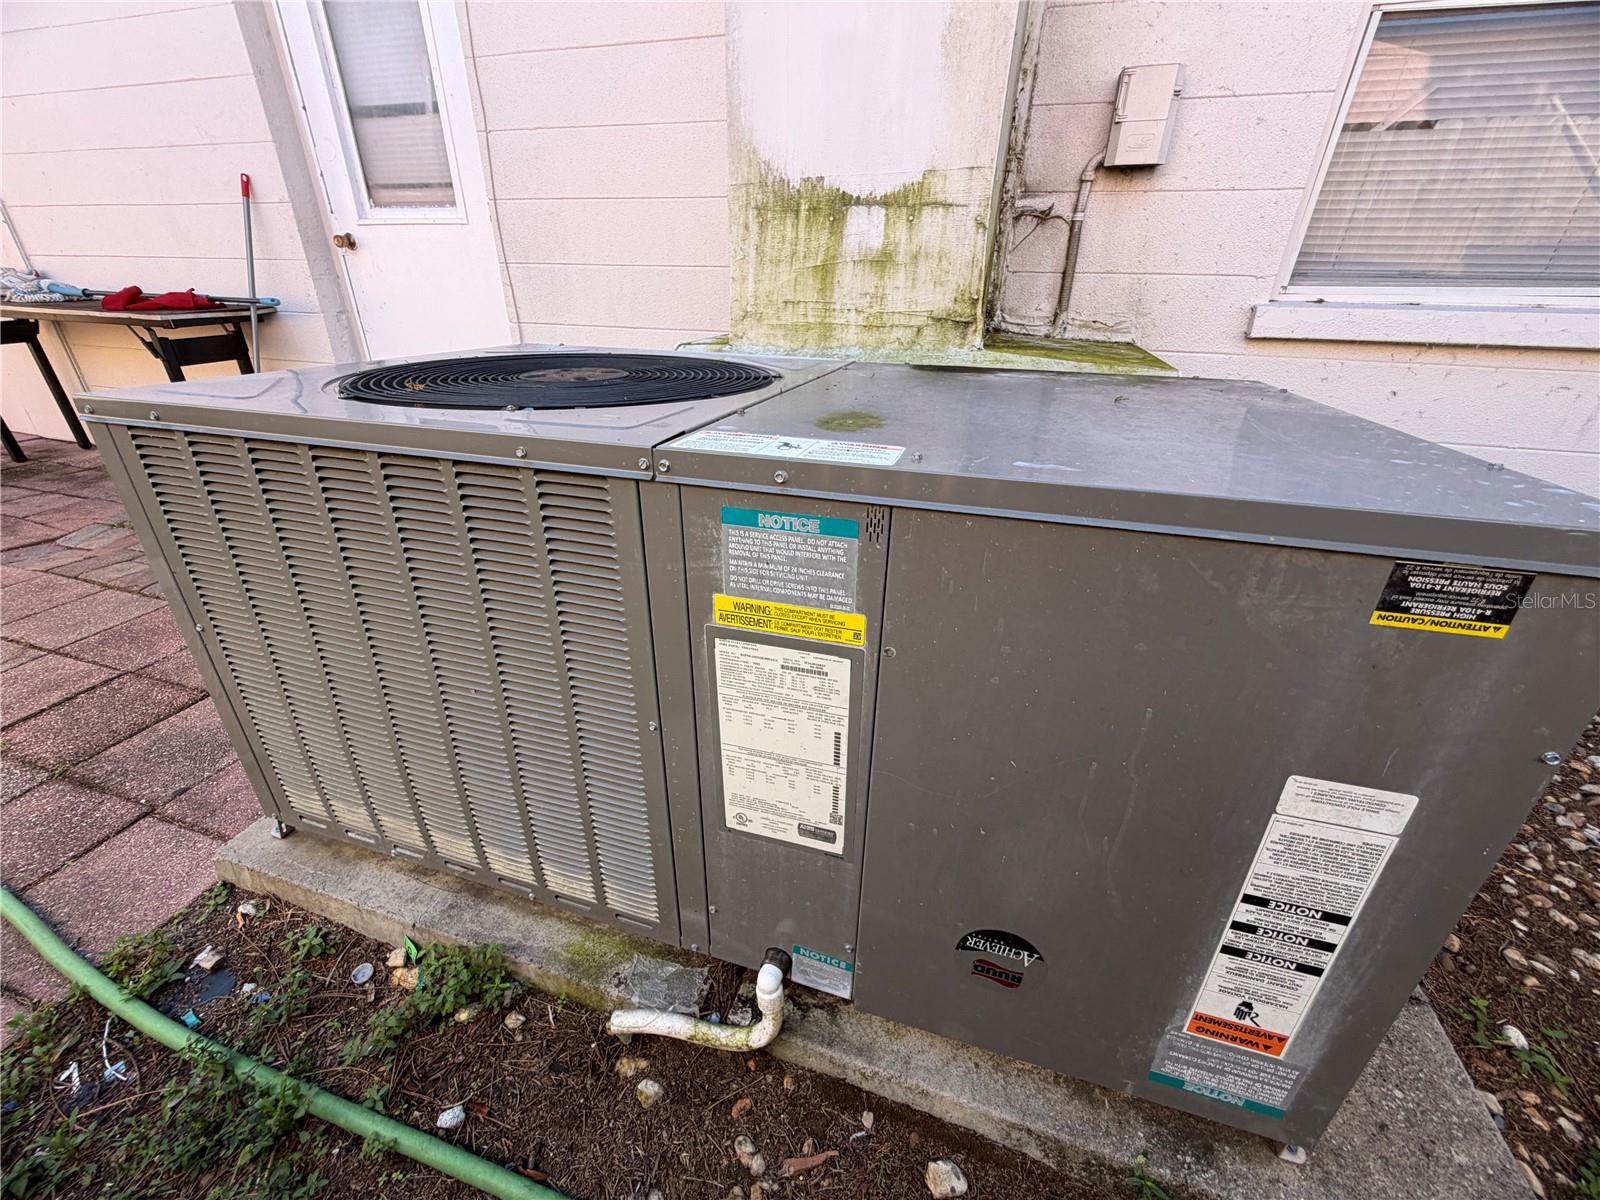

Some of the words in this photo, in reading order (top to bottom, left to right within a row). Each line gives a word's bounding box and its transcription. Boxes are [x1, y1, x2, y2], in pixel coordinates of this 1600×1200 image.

[757, 513, 819, 533] NOTICE
[1407, 574, 1451, 585] PRESSION
[1408, 581, 1441, 590] R-410A
[1451, 579, 1482, 588] HAUTE
[1482, 582, 1509, 591] SOUS
[1399, 600, 1458, 612] REFRIGERANT
[1408, 606, 1452, 617] PRESSURE
[1451, 611, 1477, 620] HIGH
[1457, 606, 1492, 615] R-410A
[1375, 613, 1491, 632] ATTENTION/CAUTION
[1266, 900, 1323, 919] NOTICE
[1254, 926, 1310, 945] NOTICE
[800, 948, 847, 969] NOTICE
[963, 935, 1039, 969] ACHIEVER
[1243, 950, 1298, 970] NOTICE
[971, 963, 1023, 984] RUUD
[1191, 1013, 1275, 1041] AVERTISSEMENT
[1194, 1025, 1261, 1048] WARNING
[1181, 1081, 1246, 1106] NOTICE
